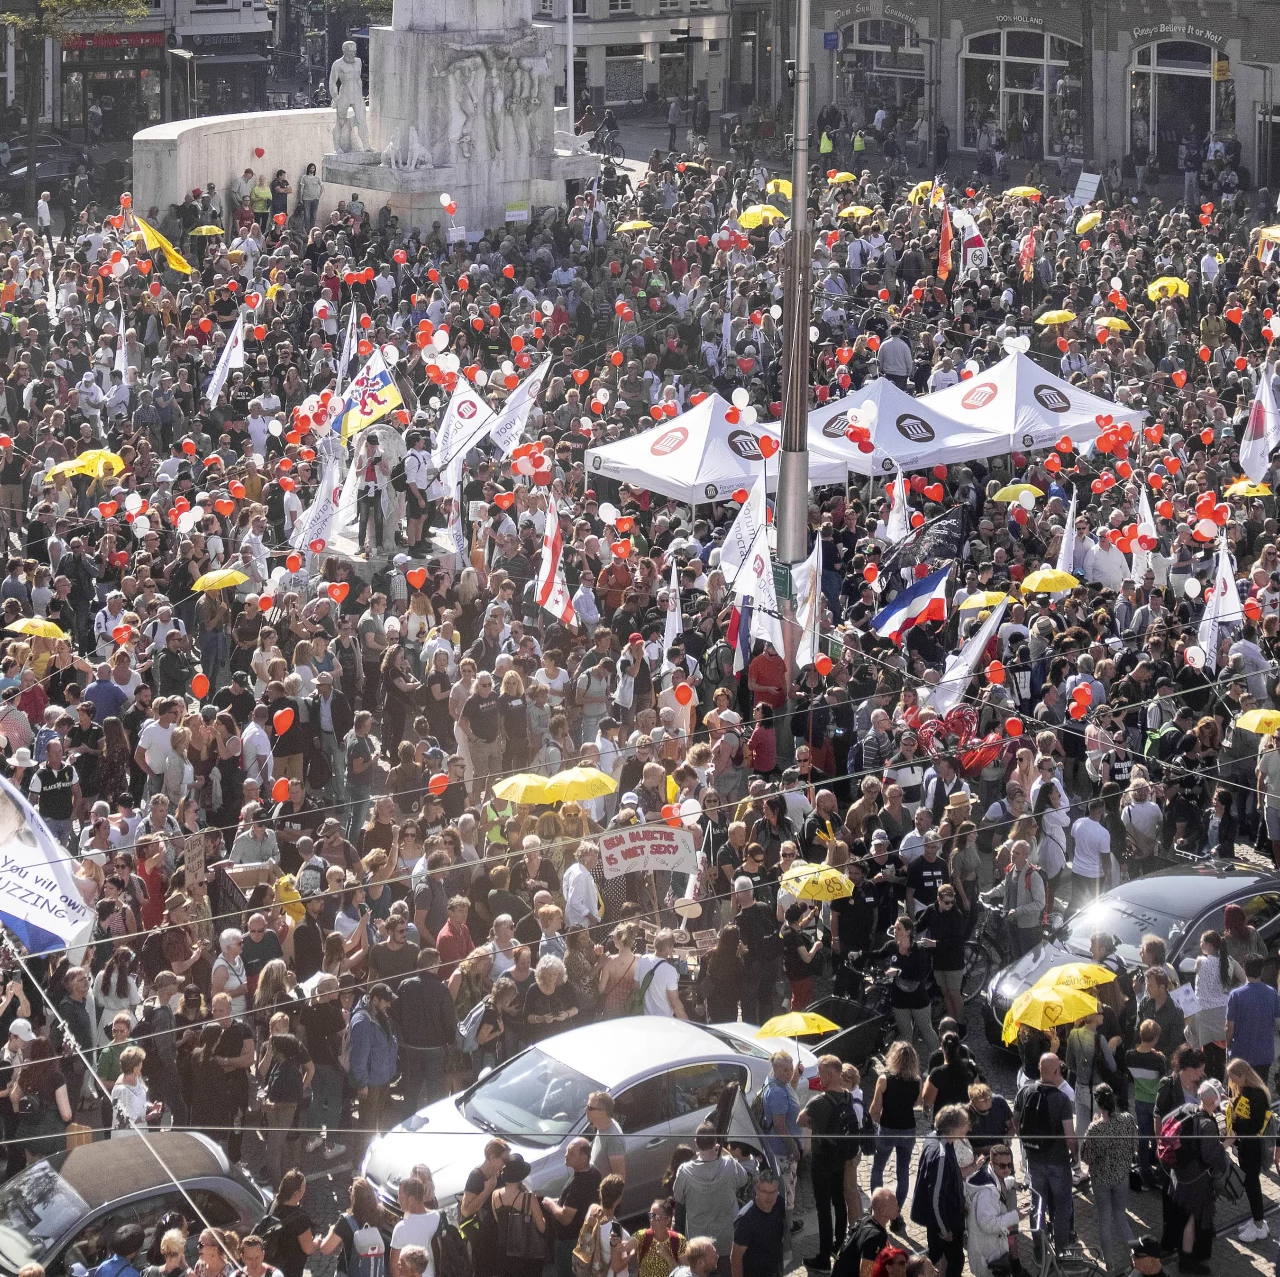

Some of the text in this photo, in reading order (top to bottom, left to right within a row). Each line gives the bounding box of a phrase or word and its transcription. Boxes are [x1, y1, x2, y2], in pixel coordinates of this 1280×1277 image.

[995, 14, 1044, 25] 100% HOLLAND
[1160, 23, 1186, 34] Believe
[628, 830, 675, 843] INJECTIE
[605, 844, 678, 867] IS NIET SEXY
[0, 854, 30, 879] You
[59, 893, 88, 917] own
[824, 876, 843, 894] 85
